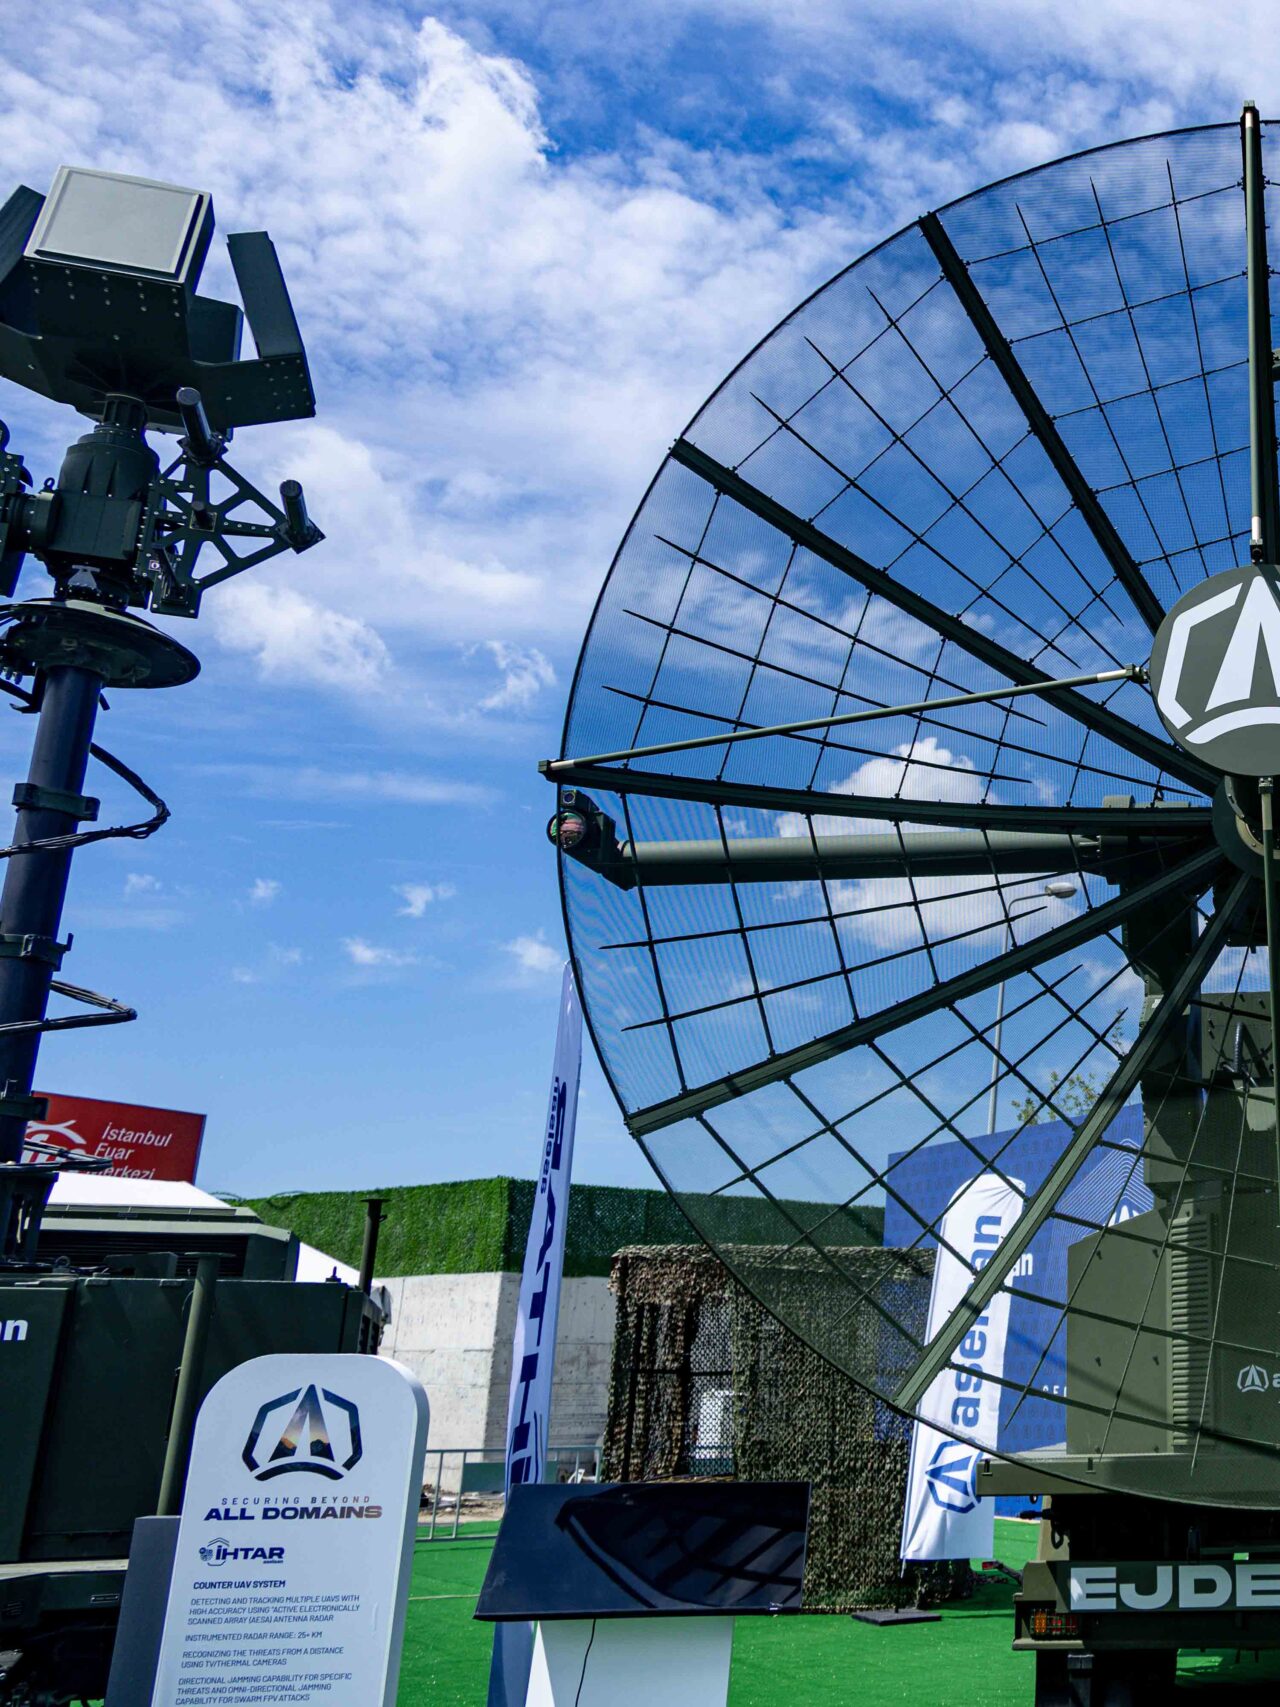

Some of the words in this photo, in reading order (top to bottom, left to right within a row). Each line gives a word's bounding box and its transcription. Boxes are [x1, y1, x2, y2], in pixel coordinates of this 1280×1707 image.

[102, 1122, 173, 1147] İstanbul
[94, 1142, 135, 1160] Fuar
[86, 1165, 156, 1180] erkezi
[222, 1497, 300, 1505] SECURING
[311, 1496, 370, 1504] BEYOND
[204, 1508, 255, 1521] ALL
[262, 1505, 382, 1520] DOMAINS
[215, 1545, 285, 1560] İHTAR
[193, 1581, 233, 1590] COUNTER
[234, 1581, 252, 1589] UAV
[253, 1580, 286, 1588] SYSTEM
[191, 1598, 231, 1606] DETECTING
[232, 1597, 248, 1605] AND
[249, 1596, 284, 1604] TRACKING
[286, 1595, 320, 1603] MULTIPLE
[341, 1594, 360, 1602] WITH
[208, 1607, 247, 1615] ACCURACY
[248, 1606, 270, 1614] USING
[299, 1604, 360, 1613] ELECTRONICALLY
[187, 1617, 223, 1625] SCANNED
[273, 1615, 308, 1623] ANTENNA
[309, 1614, 334, 1622] RADAR
[185, 1633, 242, 1641] INSTRUMENTED
[243, 1632, 268, 1640] RADAR
[182, 1650, 231, 1658] RECOGNIZING
[233, 1649, 247, 1657] THE
[309, 1647, 344, 1655] DISTANCE
[181, 1660, 204, 1669] USING
[205, 1659, 251, 1668] TV/THERMAL
[252, 1658, 288, 1666] CAMERAS
[178, 1677, 225, 1685] DIRECTIONAL
[262, 1674, 303, 1682] CAPABILITY
[319, 1672, 352, 1681] SPECIFIC
[177, 1687, 210, 1695] THREATS
[211, 1686, 227, 1694] AND
[228, 1685, 296, 1693] OMNI-DIRECTIONAL
[298, 1683, 332, 1691] JAMMING
[175, 1697, 218, 1705] CAPABILITY
[218, 1696, 233, 1704] FOR
[234, 1695, 263, 1703] SWARM
